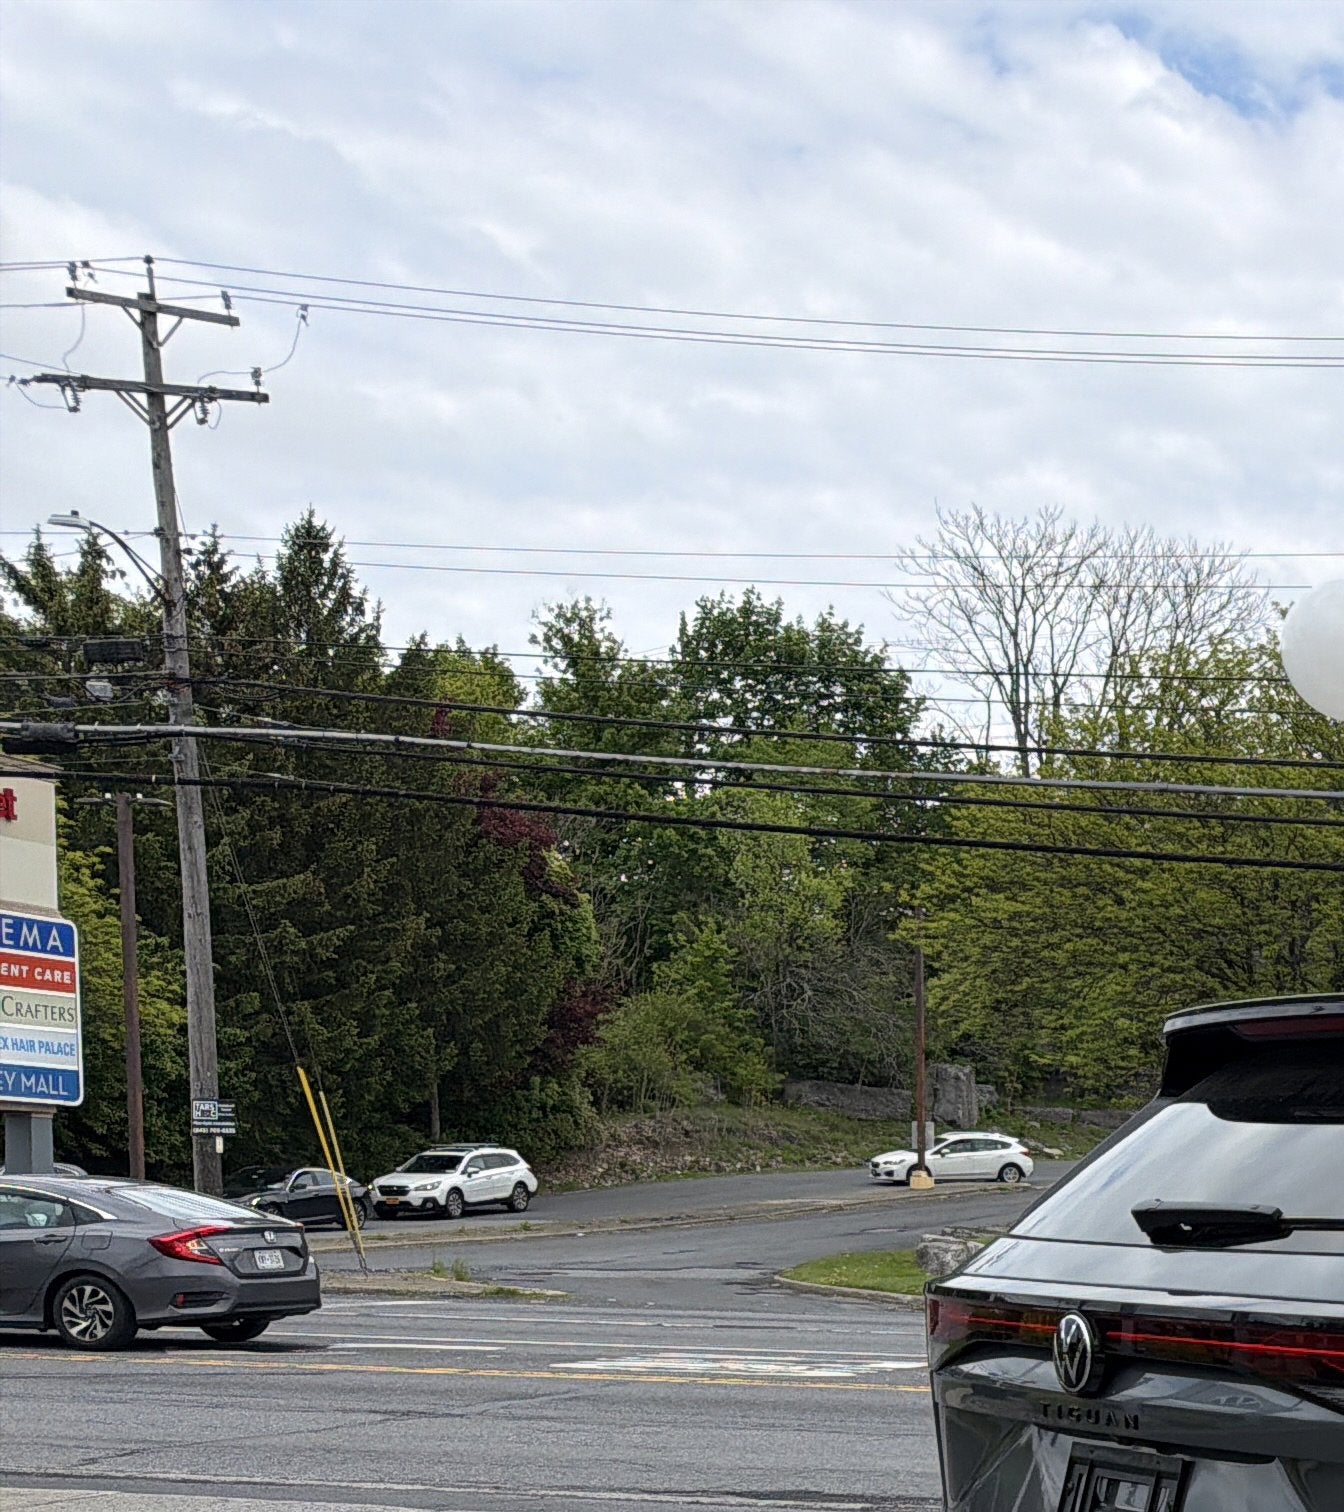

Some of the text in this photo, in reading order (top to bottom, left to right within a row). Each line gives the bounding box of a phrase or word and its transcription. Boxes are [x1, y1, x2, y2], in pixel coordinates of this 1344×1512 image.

[34, 967, 72, 984] CARE
[2, 995, 75, 1022] CRAFTERS
[11, 1037, 36, 1053] HAIR
[38, 1039, 76, 1056] PALACE
[21, 1072, 69, 1096] MALL
[1040, 1401, 1139, 1430] TIGUAN
